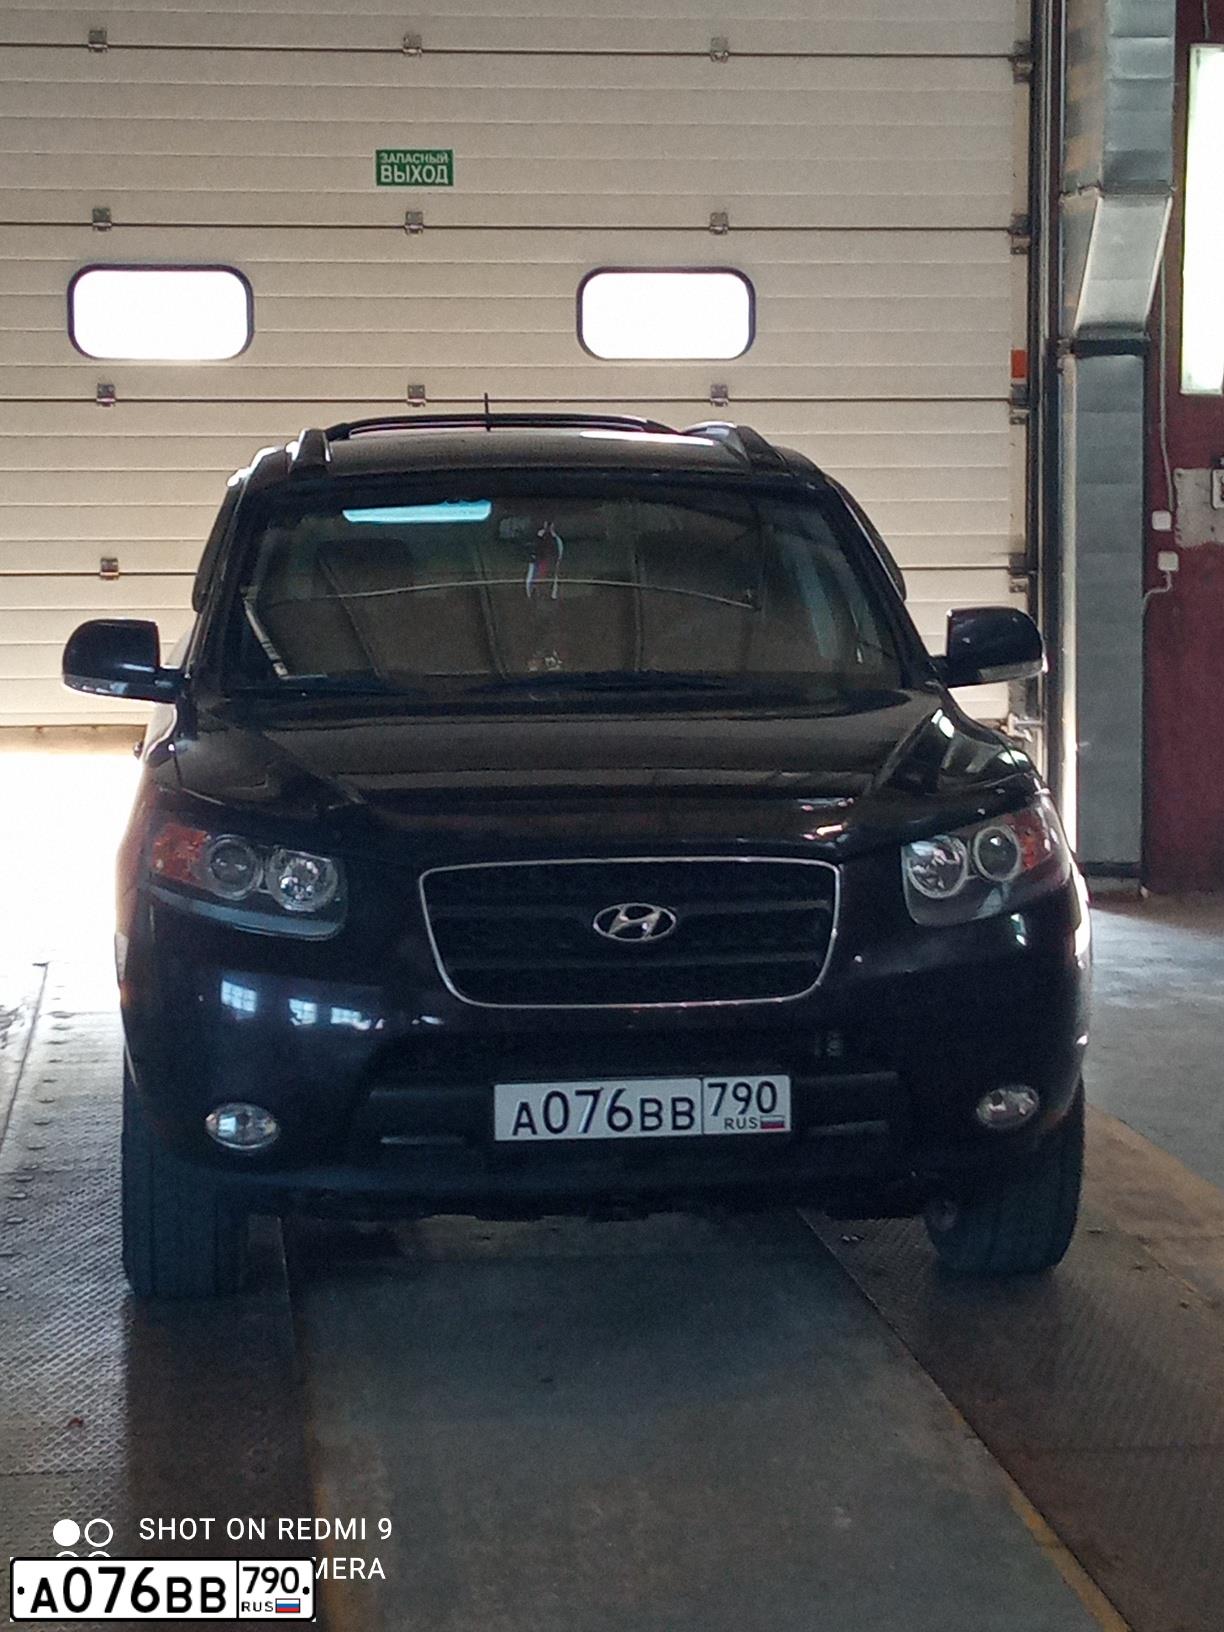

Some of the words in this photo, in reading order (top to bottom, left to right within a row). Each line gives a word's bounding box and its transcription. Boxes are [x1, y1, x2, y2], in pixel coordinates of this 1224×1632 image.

[380, 152, 448, 163] ЗАПАСНЫЙ
[381, 165, 448, 184] ВЫХОД
[708, 1081, 778, 1117] 790
[724, 1117, 759, 1130] RUS
